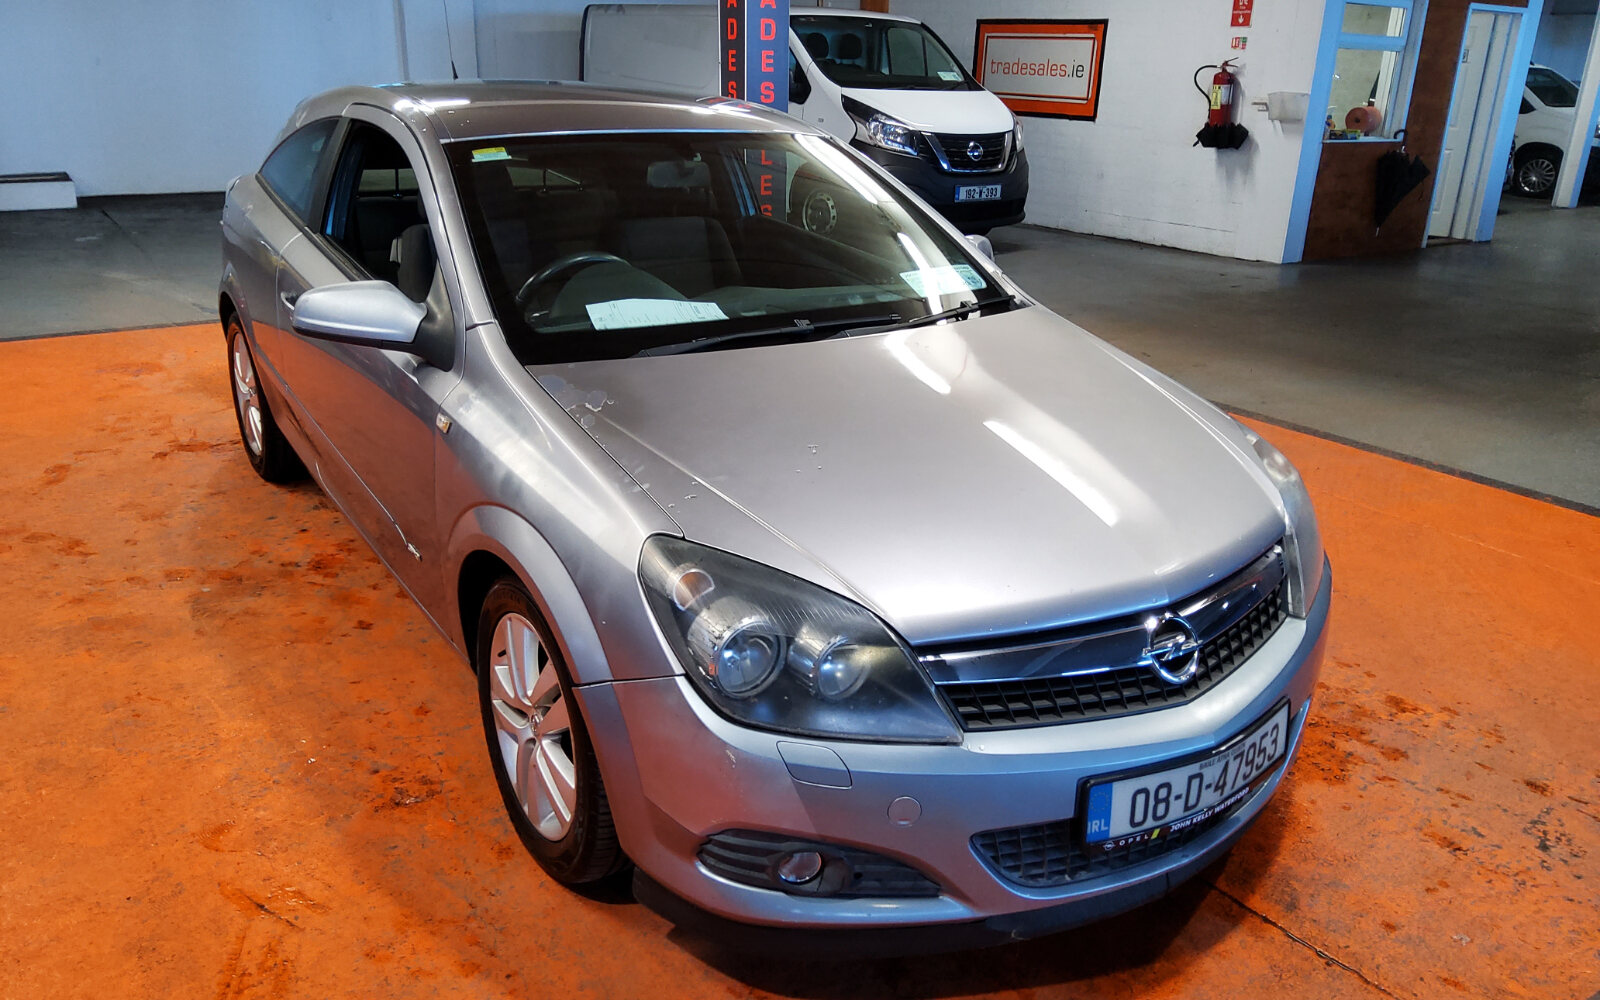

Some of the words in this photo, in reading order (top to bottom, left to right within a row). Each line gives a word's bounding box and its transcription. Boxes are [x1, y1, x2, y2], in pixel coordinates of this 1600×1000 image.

[990, 57, 1085, 78] tradesales.ie
[965, 187, 998, 199] 192-W-393
[1129, 722, 1280, 829] 08-D-47953
[1170, 819, 1191, 832] JOHN
[1192, 809, 1213, 824] KELLY
[1214, 786, 1250, 814] WATERFORD
[1087, 819, 1109, 835] IRL
[1119, 833, 1149, 846] OPEL
